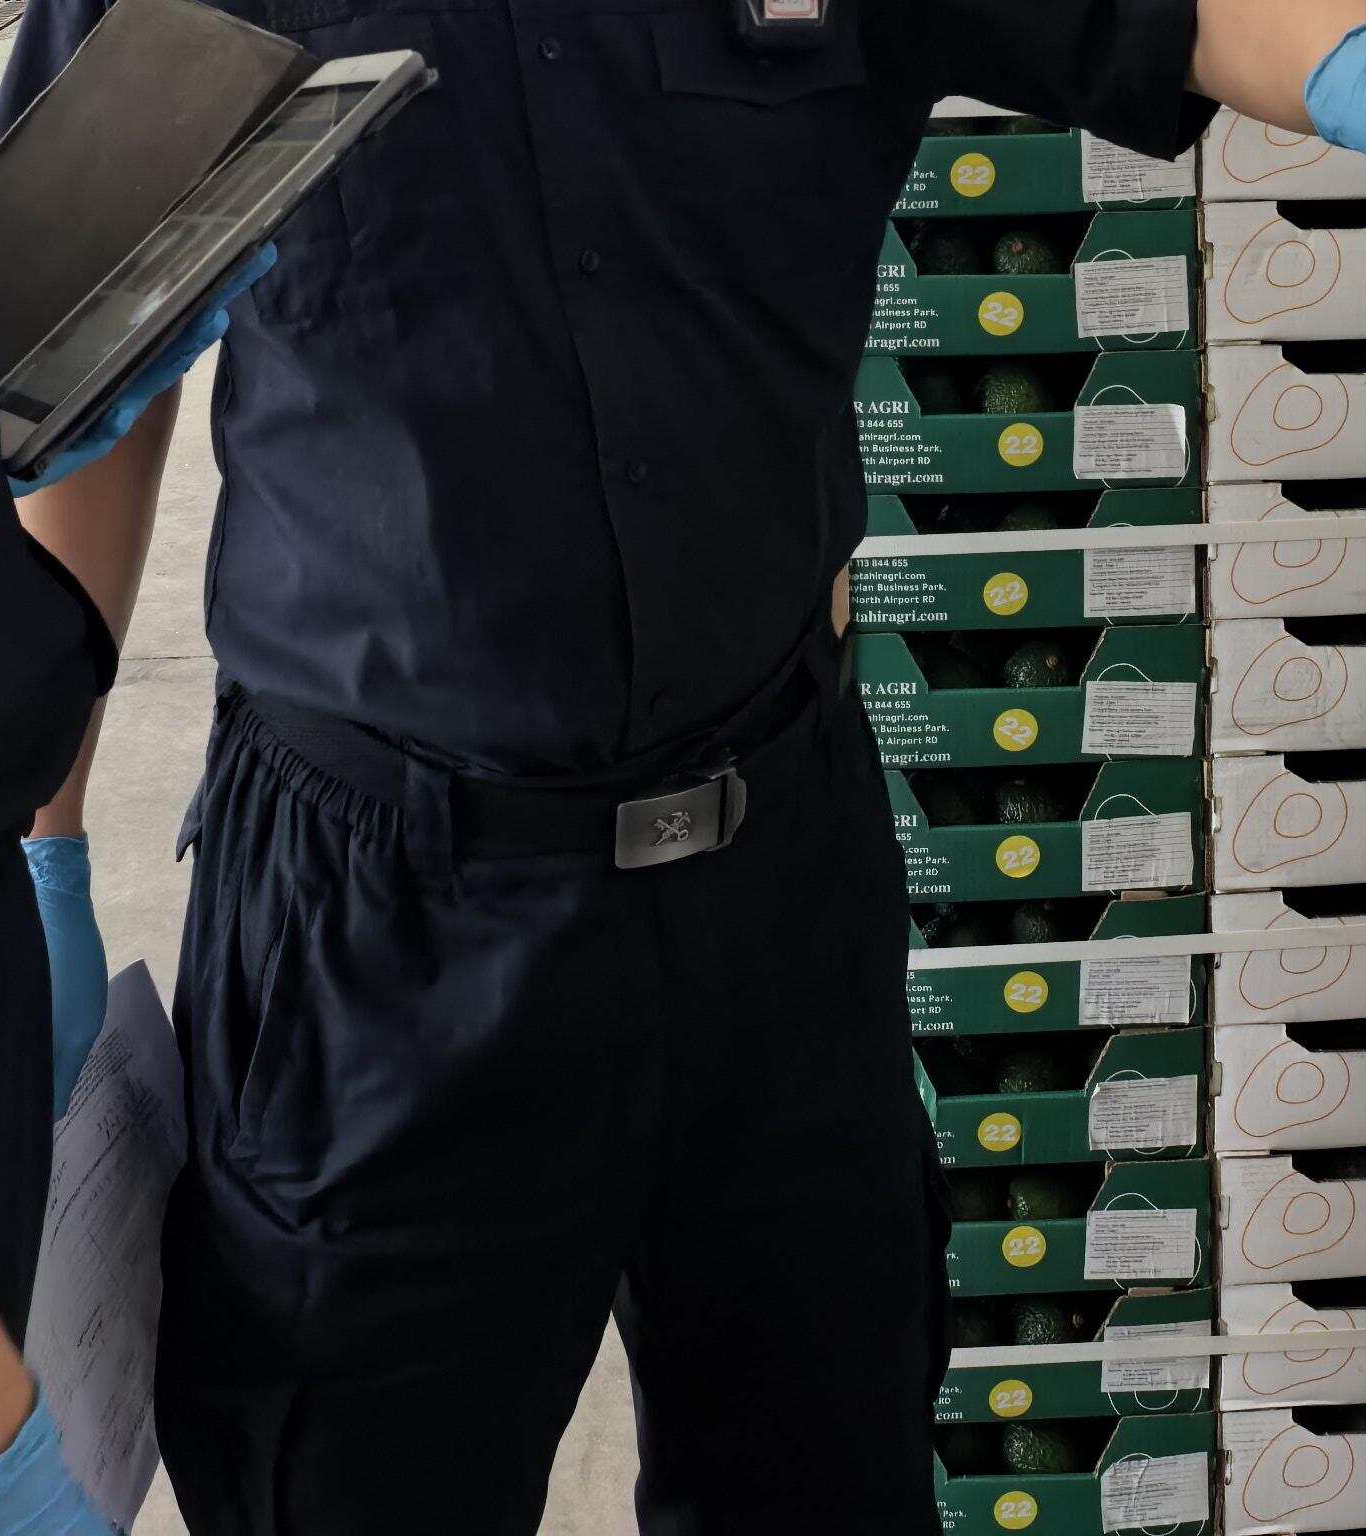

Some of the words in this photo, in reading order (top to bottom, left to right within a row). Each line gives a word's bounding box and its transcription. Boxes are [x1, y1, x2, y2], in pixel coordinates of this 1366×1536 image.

[955, 165, 991, 184] 22
[914, 183, 926, 192] RD
[877, 264, 906, 278] GRI
[883, 283, 900, 292] 655
[873, 308, 911, 318] usiness
[982, 300, 1018, 327] 22
[875, 321, 911, 331] Airport
[914, 320, 927, 329] RD
[868, 401, 910, 414] AGRI
[867, 419, 885, 428] 844
[887, 419, 904, 428] 655
[873, 444, 915, 453] Business
[1003, 434, 1039, 455] 22
[879, 456, 915, 467] Airport
[918, 456, 931, 465] RD
[865, 471, 944, 486] hiragri.com
[871, 559, 890, 567] 844
[892, 558, 908, 567] 655
[877, 583, 919, 592] Business
[883, 595, 919, 606] Airport
[922, 595, 936, 604] RD
[989, 582, 1024, 607] 22
[856, 610, 948, 625] tahiragri.com
[875, 682, 917, 695] AGRI
[875, 701, 893, 710] 844
[895, 700, 911, 709] 655
[880, 725, 922, 734] Business
[999, 717, 1033, 745] 22
[887, 737, 923, 747] Airport
[925, 736, 938, 745] RD
[894, 814, 918, 827] GRI
[895, 833, 912, 842] 655
[1002, 844, 1037, 870] 22
[925, 869, 939, 877] RD
[1010, 983, 1043, 1003] 22
[928, 1006, 942, 1015] RD
[984, 1124, 1017, 1143] 22
[1010, 1236, 1042, 1256] 22
[996, 1390, 1028, 1409] 22
[1000, 1500, 1033, 1519] 22
